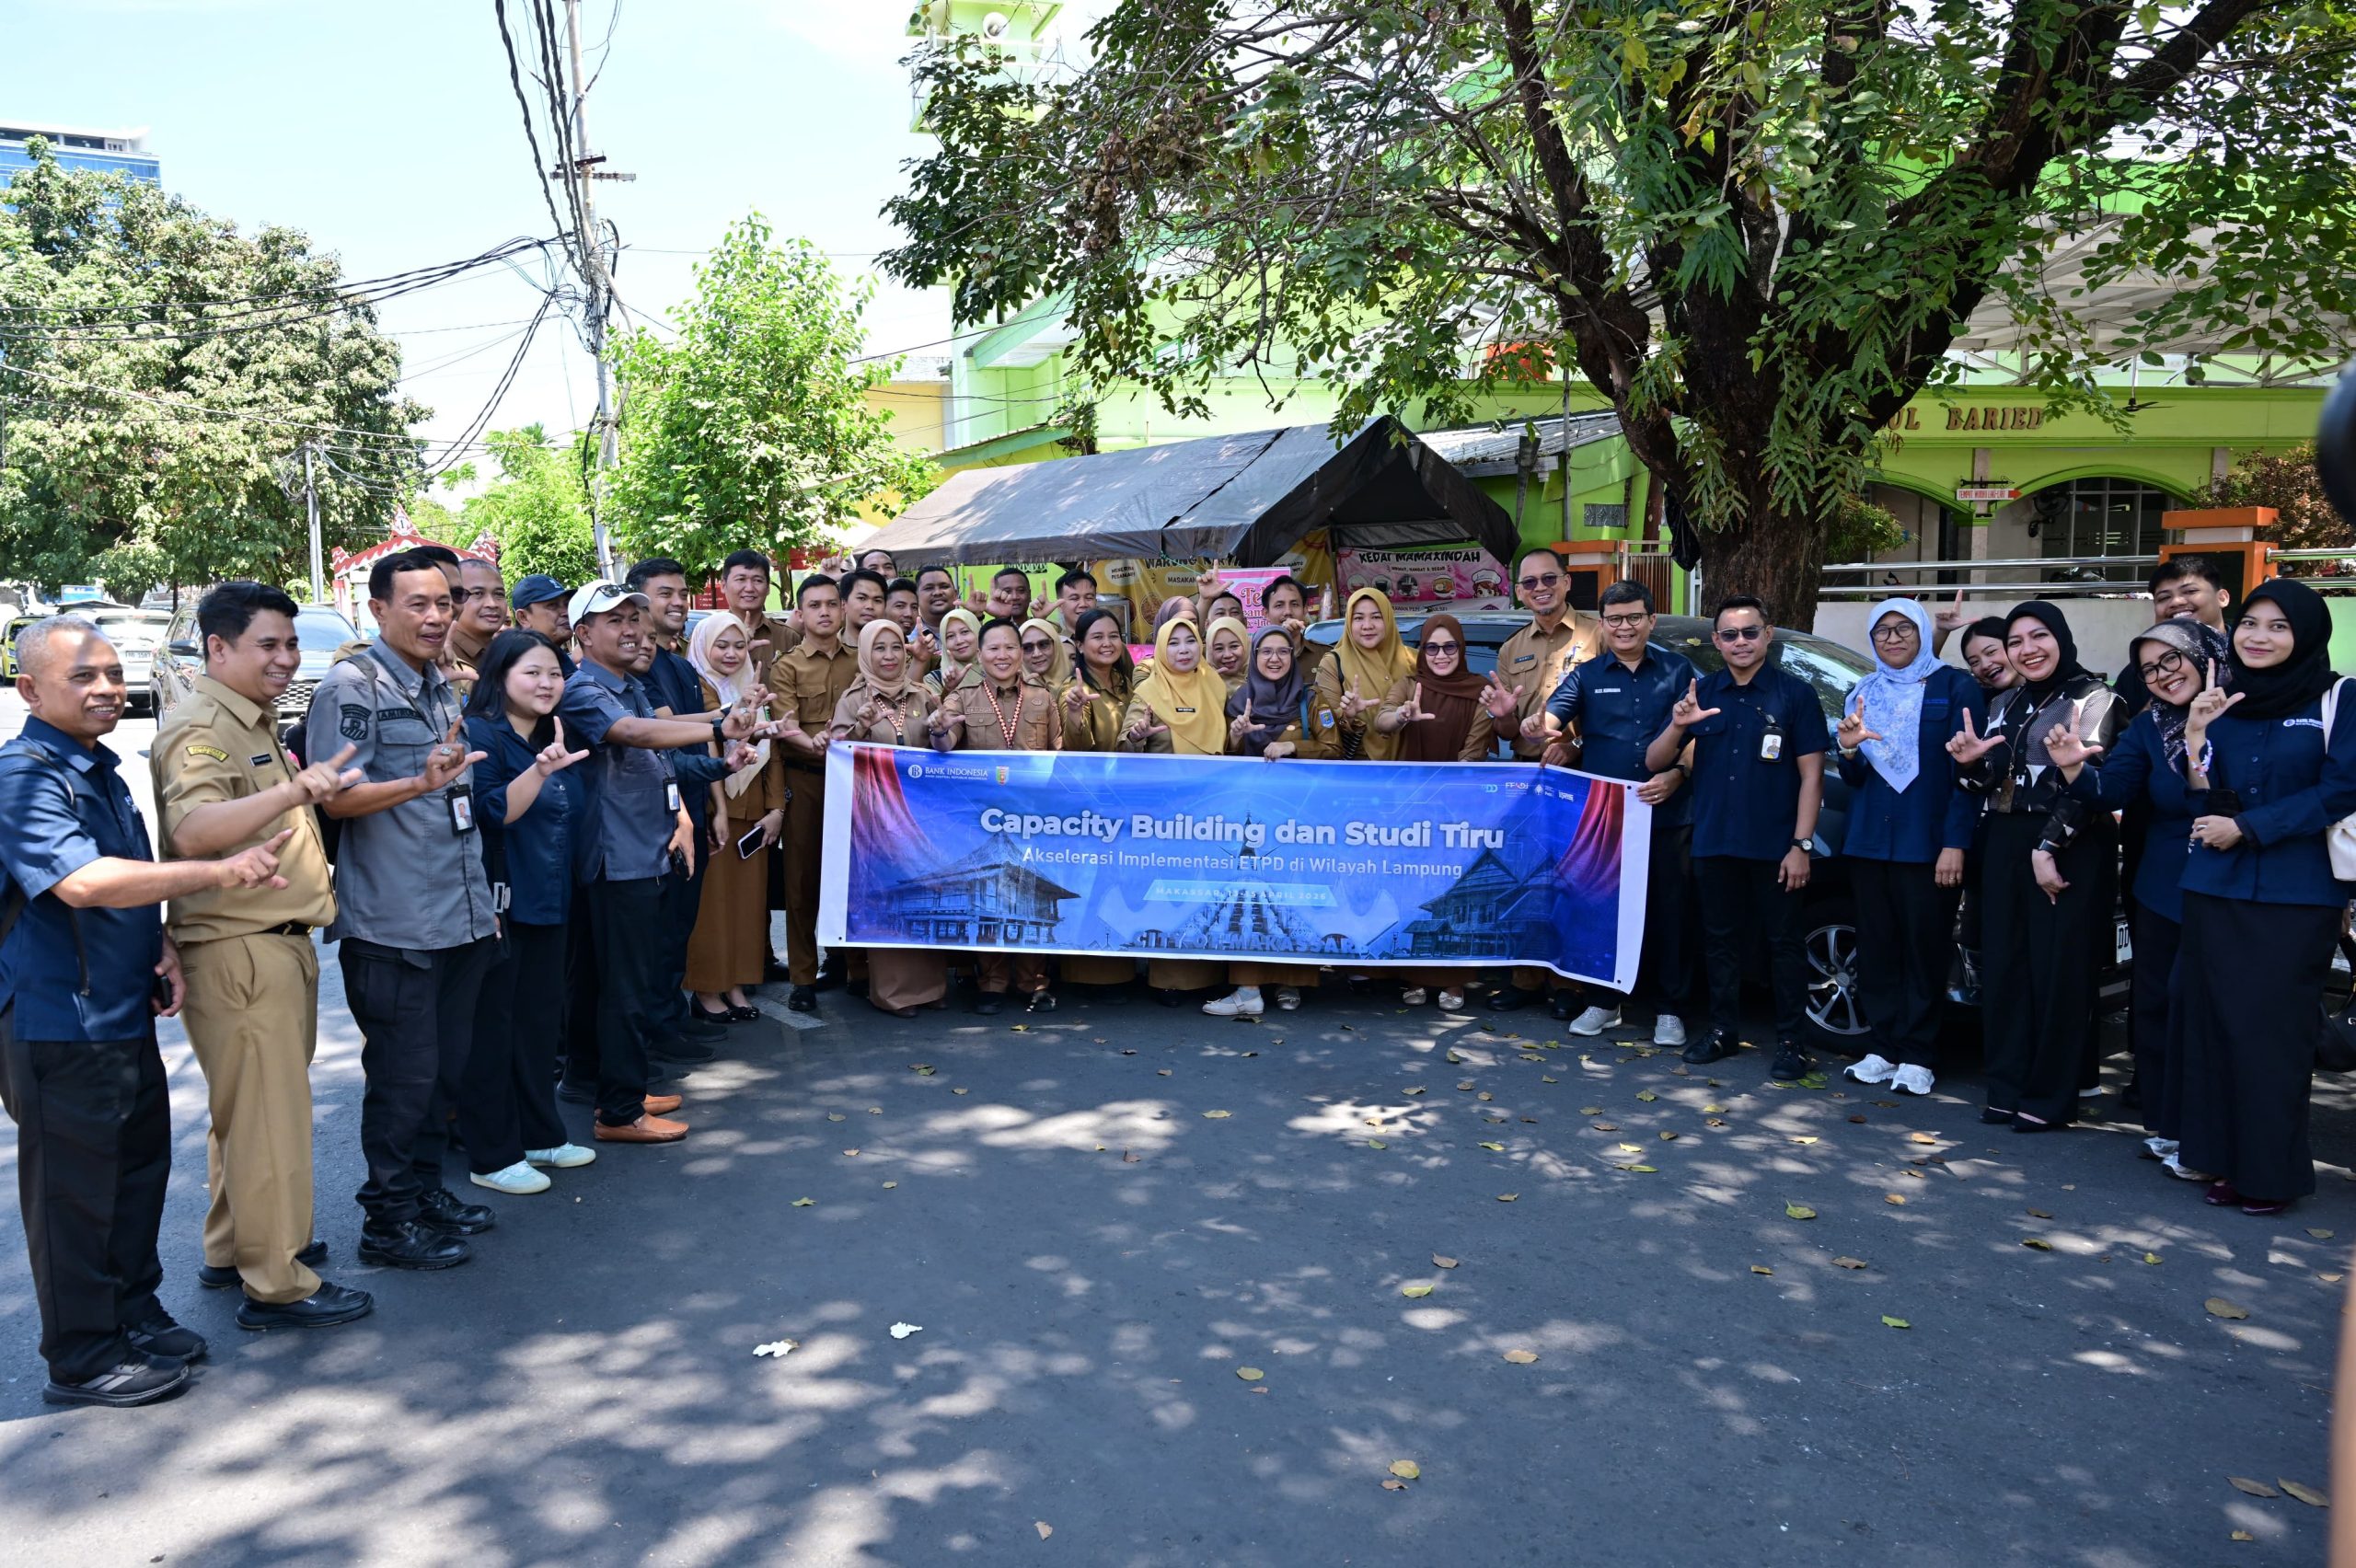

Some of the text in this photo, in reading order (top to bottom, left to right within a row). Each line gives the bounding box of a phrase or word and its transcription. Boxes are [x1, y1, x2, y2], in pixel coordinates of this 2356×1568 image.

[1885, 407, 2044, 431] UL BARIED
[925, 767, 988, 778] BANK INDONESIA
[980, 808, 1504, 849] Capacity Building dan Studi Tiru
[1022, 847, 1462, 879] Akselerasi Implementasi ETPD di Wilayah Lampung
[1260, 891, 1295, 900] APRIL
